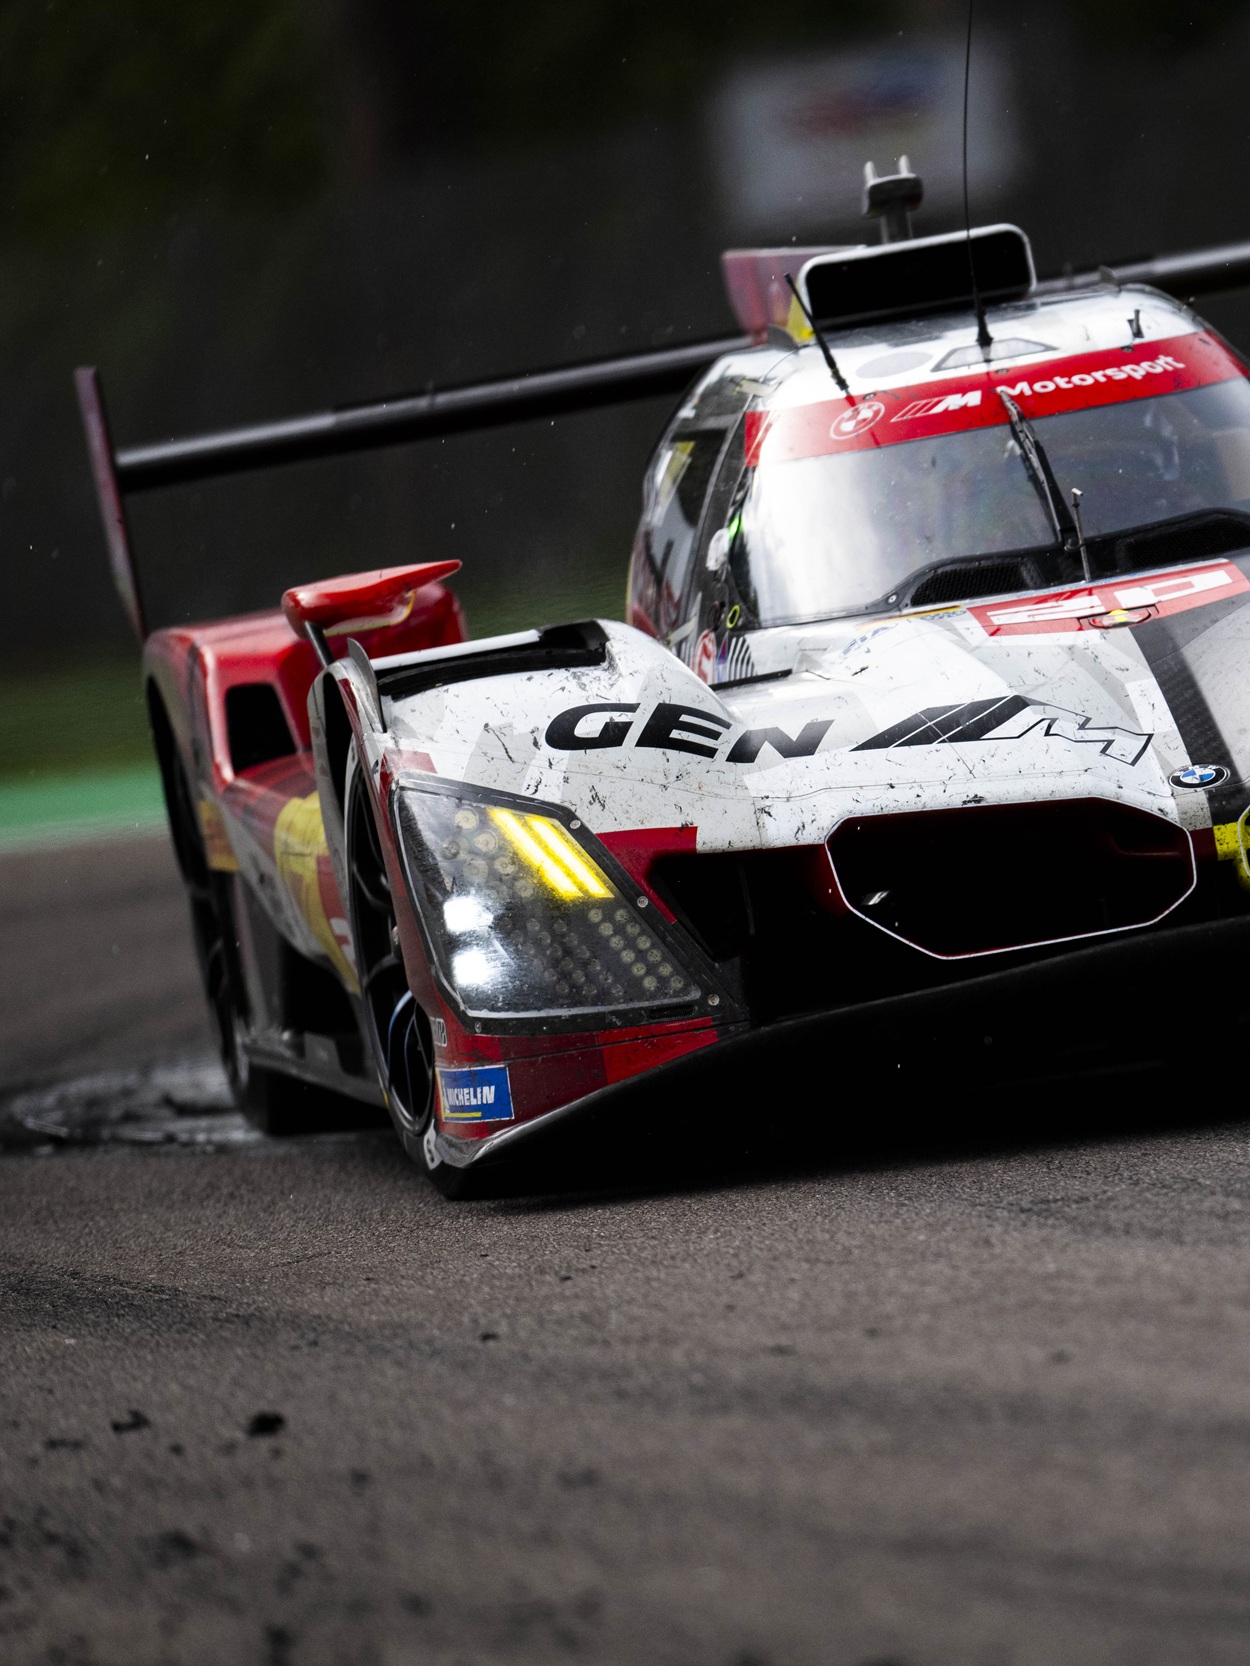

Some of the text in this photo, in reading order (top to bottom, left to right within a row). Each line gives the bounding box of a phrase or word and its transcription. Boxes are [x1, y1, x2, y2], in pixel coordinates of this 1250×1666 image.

[996, 354, 1186, 398] Motorsport
[545, 702, 835, 764] GEN
[445, 1085, 496, 1107] MICHELIN
